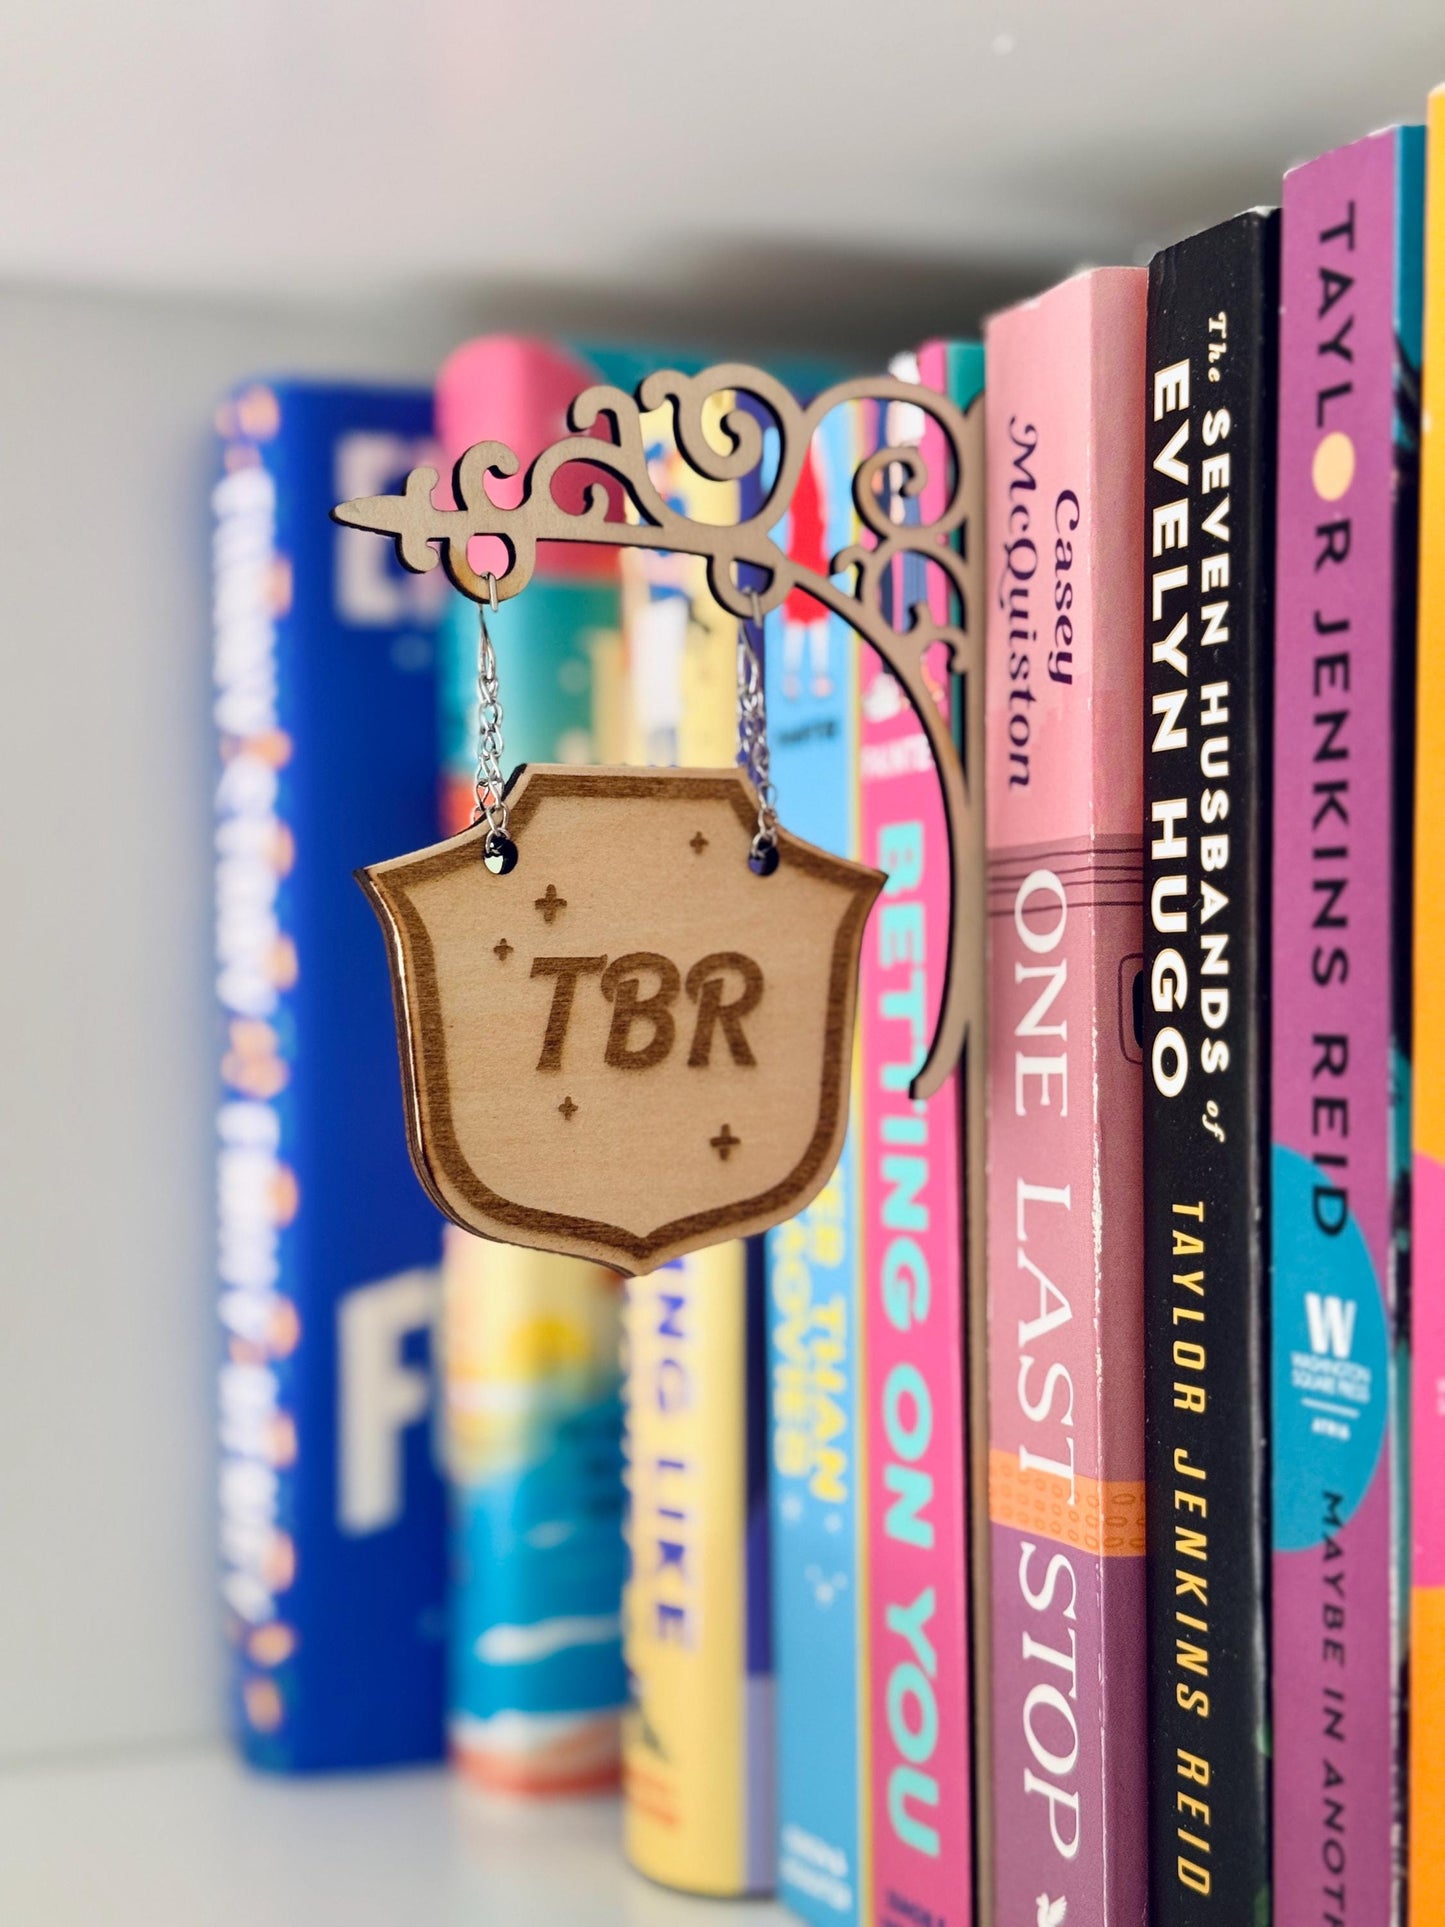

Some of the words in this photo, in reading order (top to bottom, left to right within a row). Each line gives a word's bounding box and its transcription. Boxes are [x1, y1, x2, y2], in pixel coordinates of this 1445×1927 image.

[1207, 310, 1229, 384] The
[999, 414, 1039, 788] McQuiston
[1047, 488, 1081, 686] Casey
[1150, 357, 1191, 754] EVELYN
[1200, 407, 1231, 647] SEVEN
[1199, 681, 1230, 1075] HUSBANDS
[1310, 611, 1353, 988] JENKINS
[529, 951, 765, 1075] TBR
[1013, 868, 1068, 1118] ONE
[1150, 796, 1190, 1099] HUGO
[877, 820, 932, 1332] BETTING
[1201, 1099, 1226, 1144] of
[1310, 1033, 1349, 1238] REID
[1016, 1178, 1076, 1507] LAST
[1171, 1200, 1208, 1414] TAYLOR
[881, 1362, 935, 1550] ON
[1019, 1540, 1082, 1860] STOP
[1172, 1447, 1210, 1718] JENKINS
[1321, 1491, 1344, 1669] MAYBE
[884, 1587, 940, 1859] YOU
[1175, 1747, 1211, 1896] REID
[1322, 1688, 1345, 1742] IN
